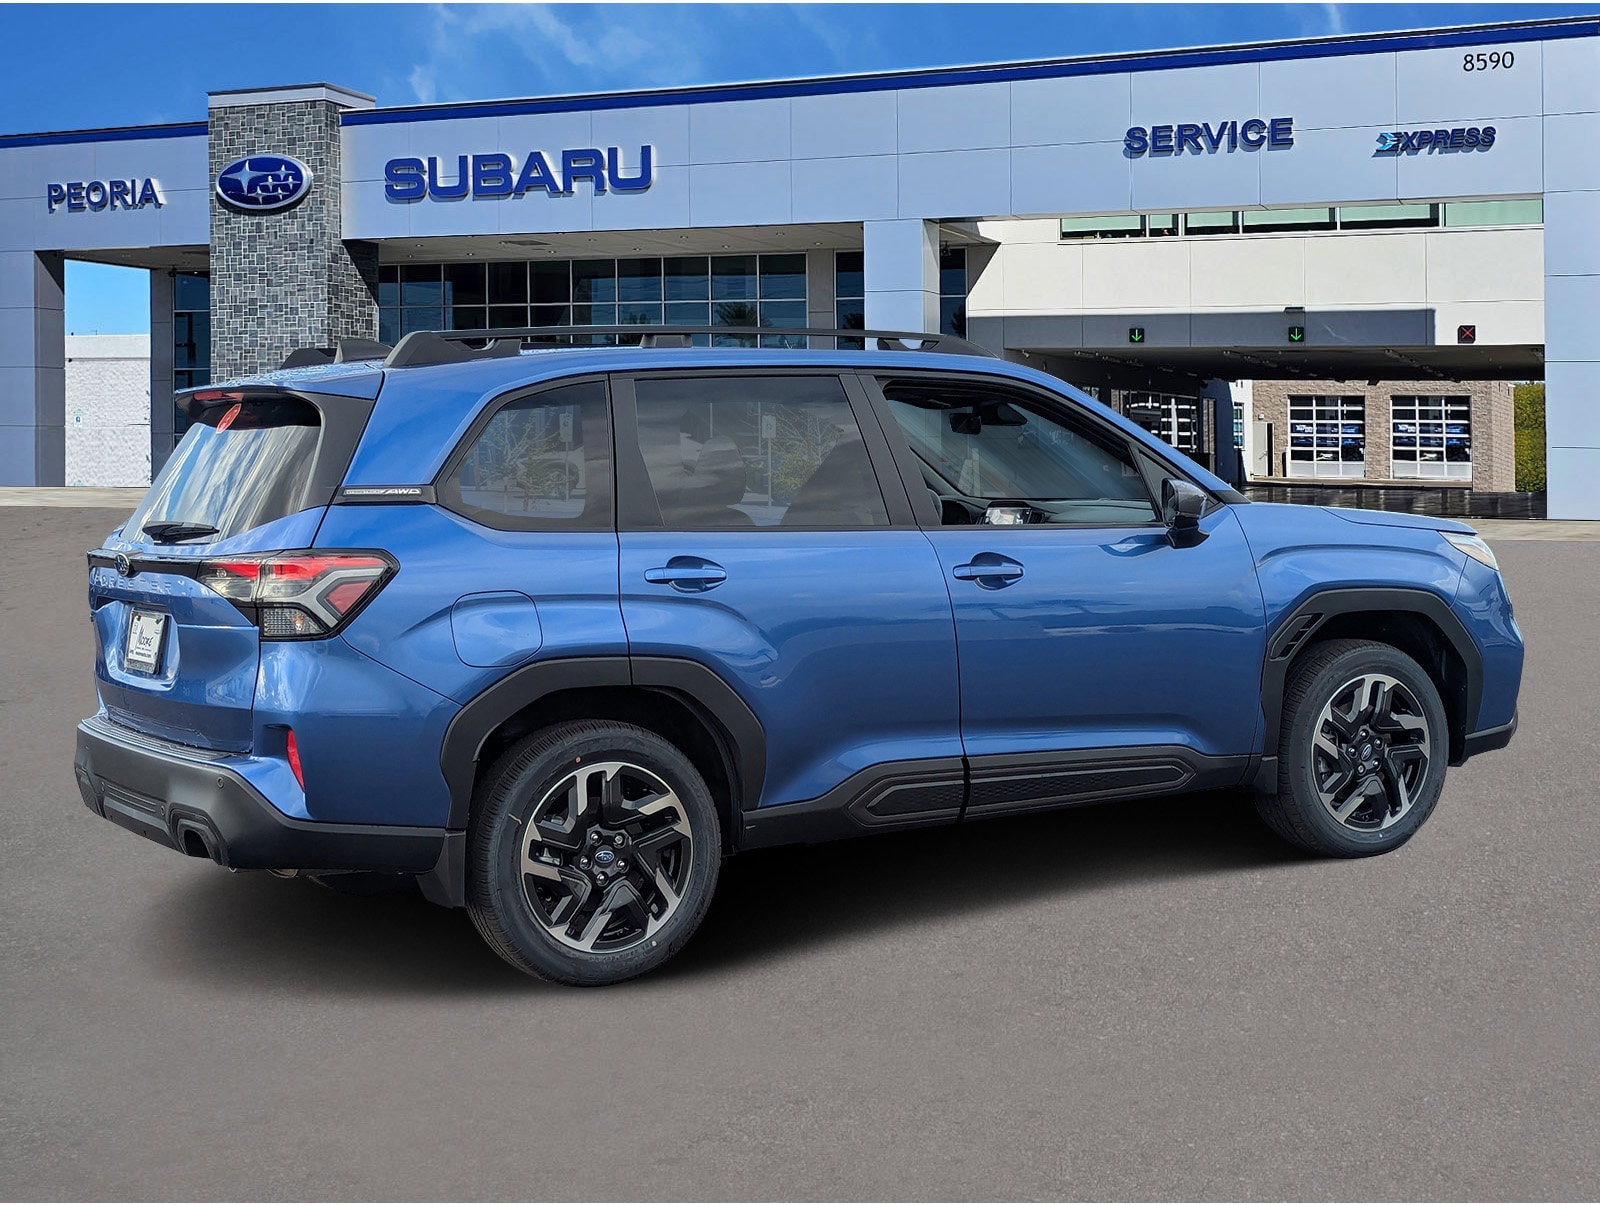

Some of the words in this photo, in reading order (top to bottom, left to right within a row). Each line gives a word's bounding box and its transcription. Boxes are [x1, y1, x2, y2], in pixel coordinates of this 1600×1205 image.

[1463, 51, 1515, 72] 8590
[1124, 117, 1294, 155] SERVICE
[1376, 126, 1497, 153] EXPRESS
[384, 145, 652, 202] SUBARU
[47, 178, 163, 213] PEORIA
[384, 487, 421, 495] AWD
